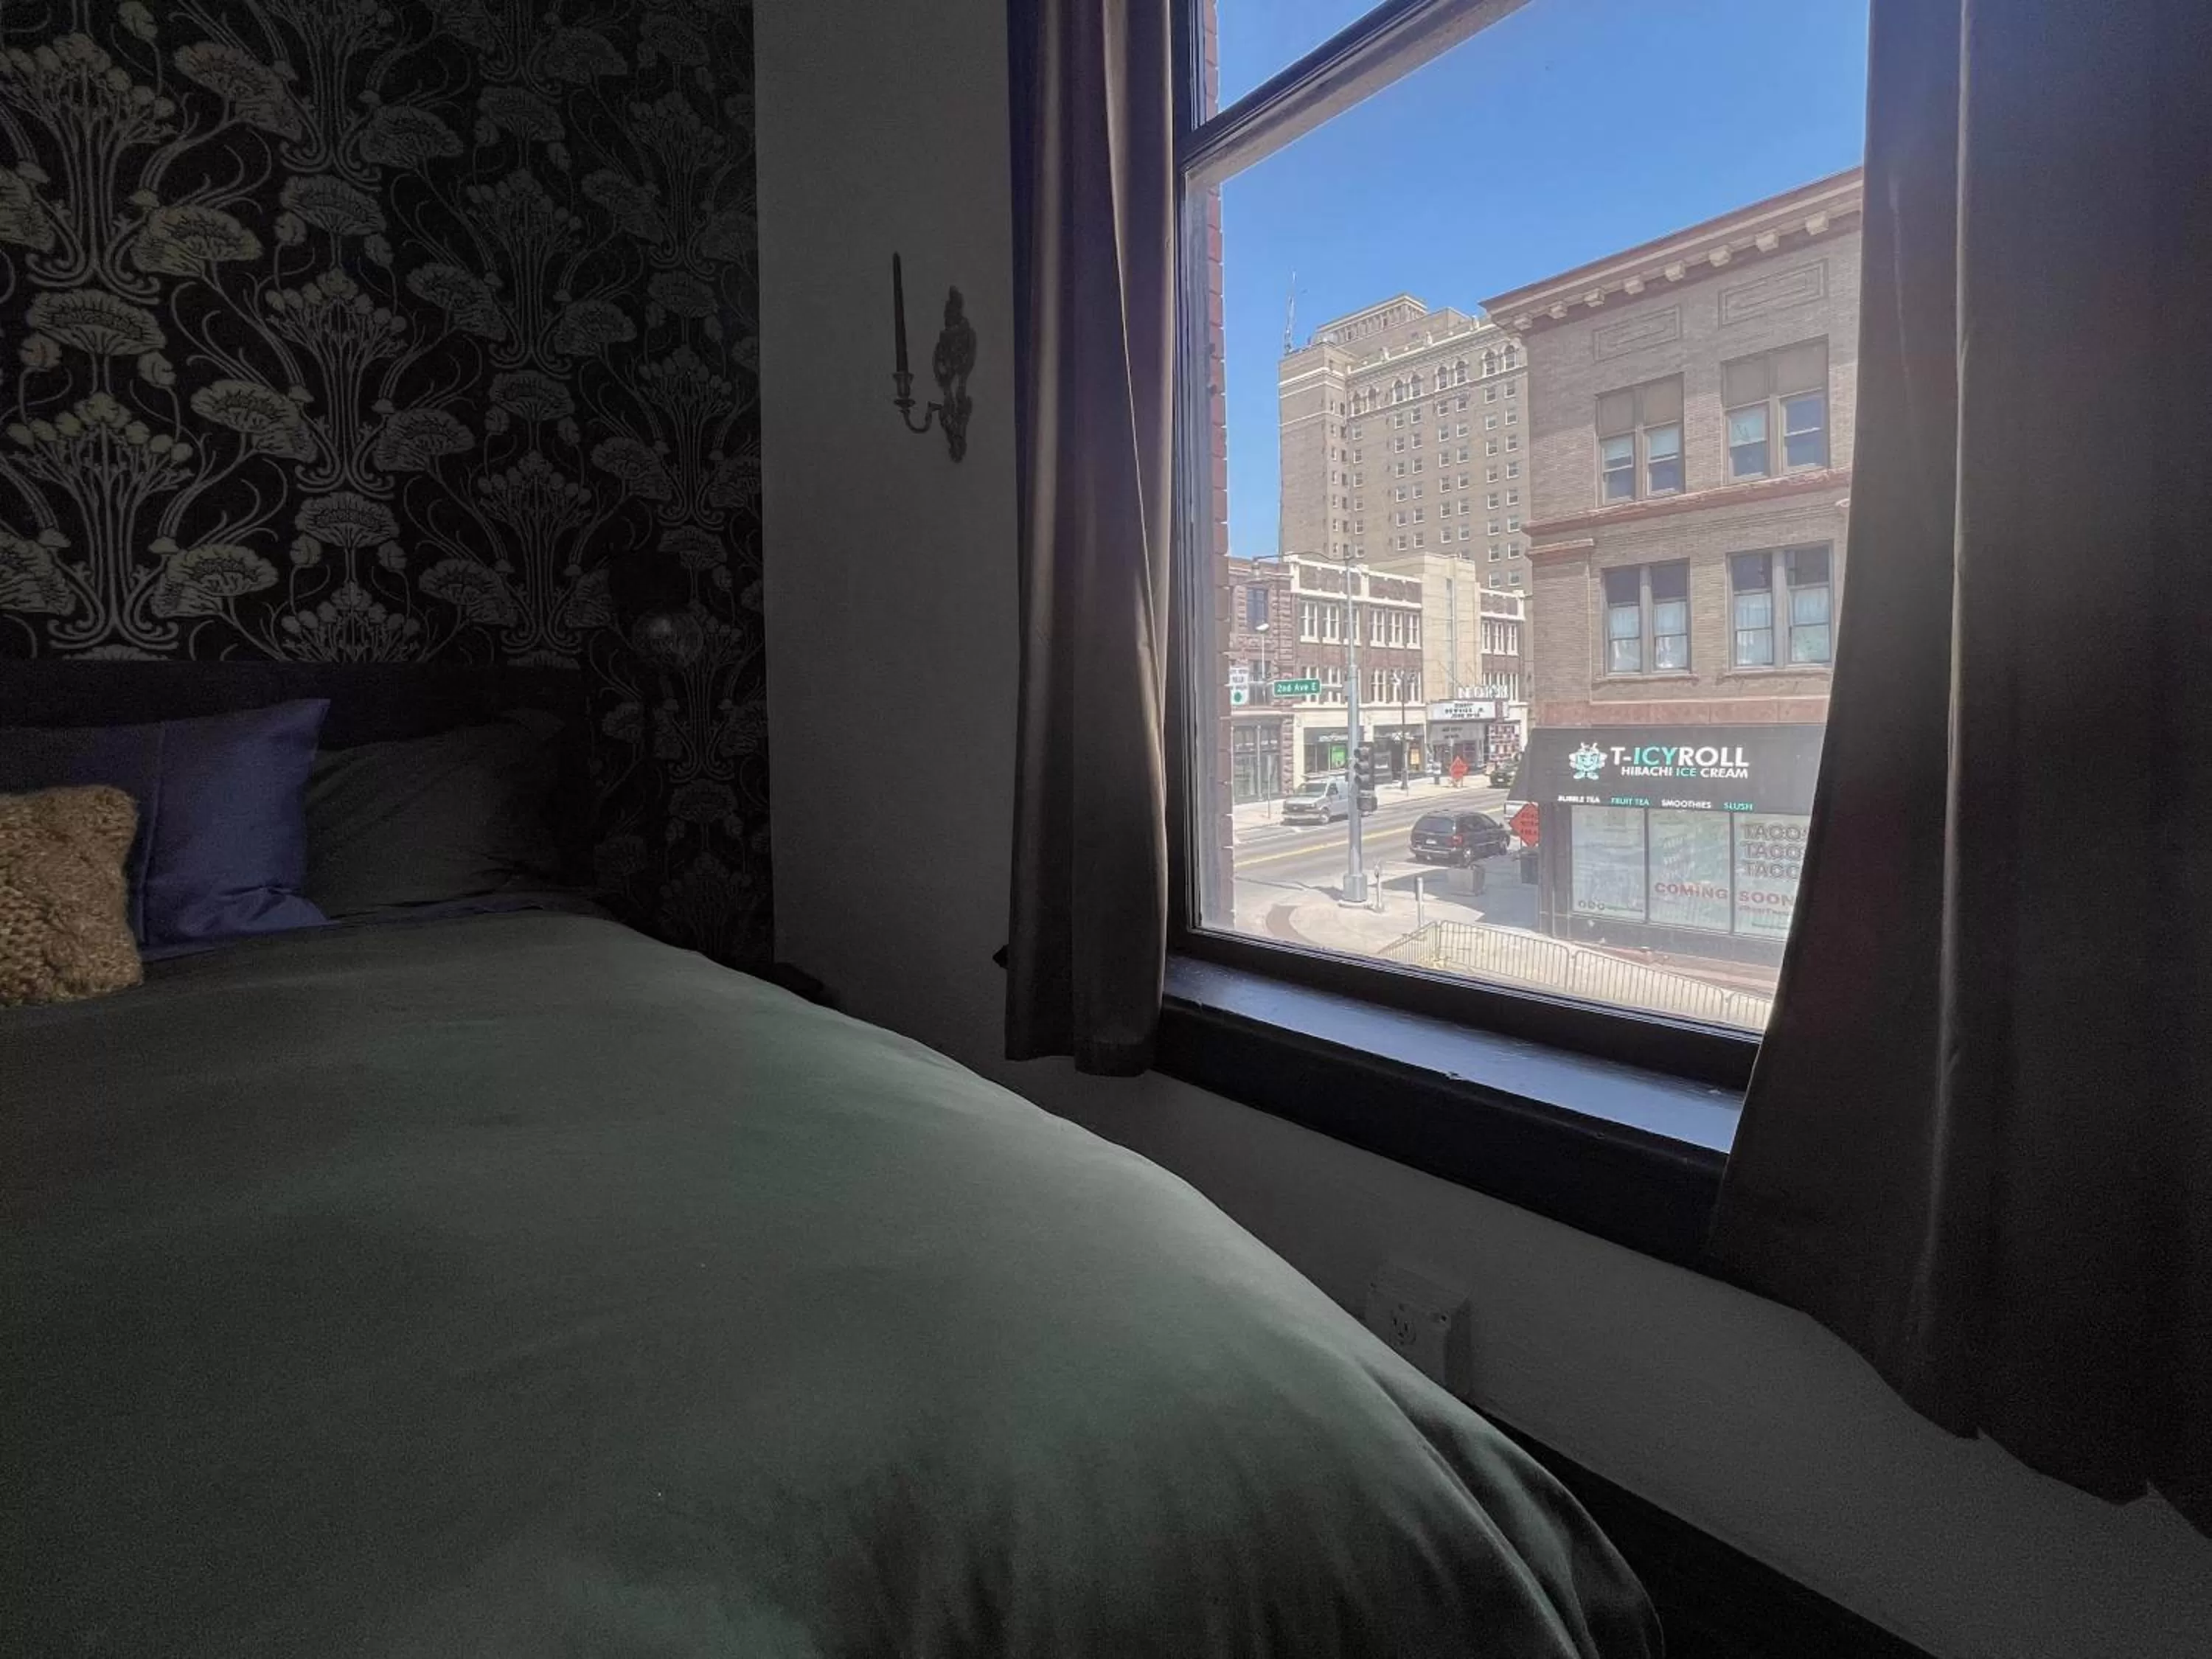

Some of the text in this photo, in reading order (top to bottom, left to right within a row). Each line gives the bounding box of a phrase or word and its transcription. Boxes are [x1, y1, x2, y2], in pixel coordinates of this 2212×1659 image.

[1277, 681, 1316, 693] 2nd Ave E
[1610, 745, 1750, 768] T-ICYROLL
[1621, 766, 1748, 779] HIBACHI ICE CREAM
[1611, 797, 1649, 806] FRUIT TEA
[1661, 799, 1711, 809] SMOOTHIES
[1723, 801, 1753, 810] SLUSH
[1742, 842, 1805, 860] TACO
[1655, 883, 1795, 906] COMING SOON
